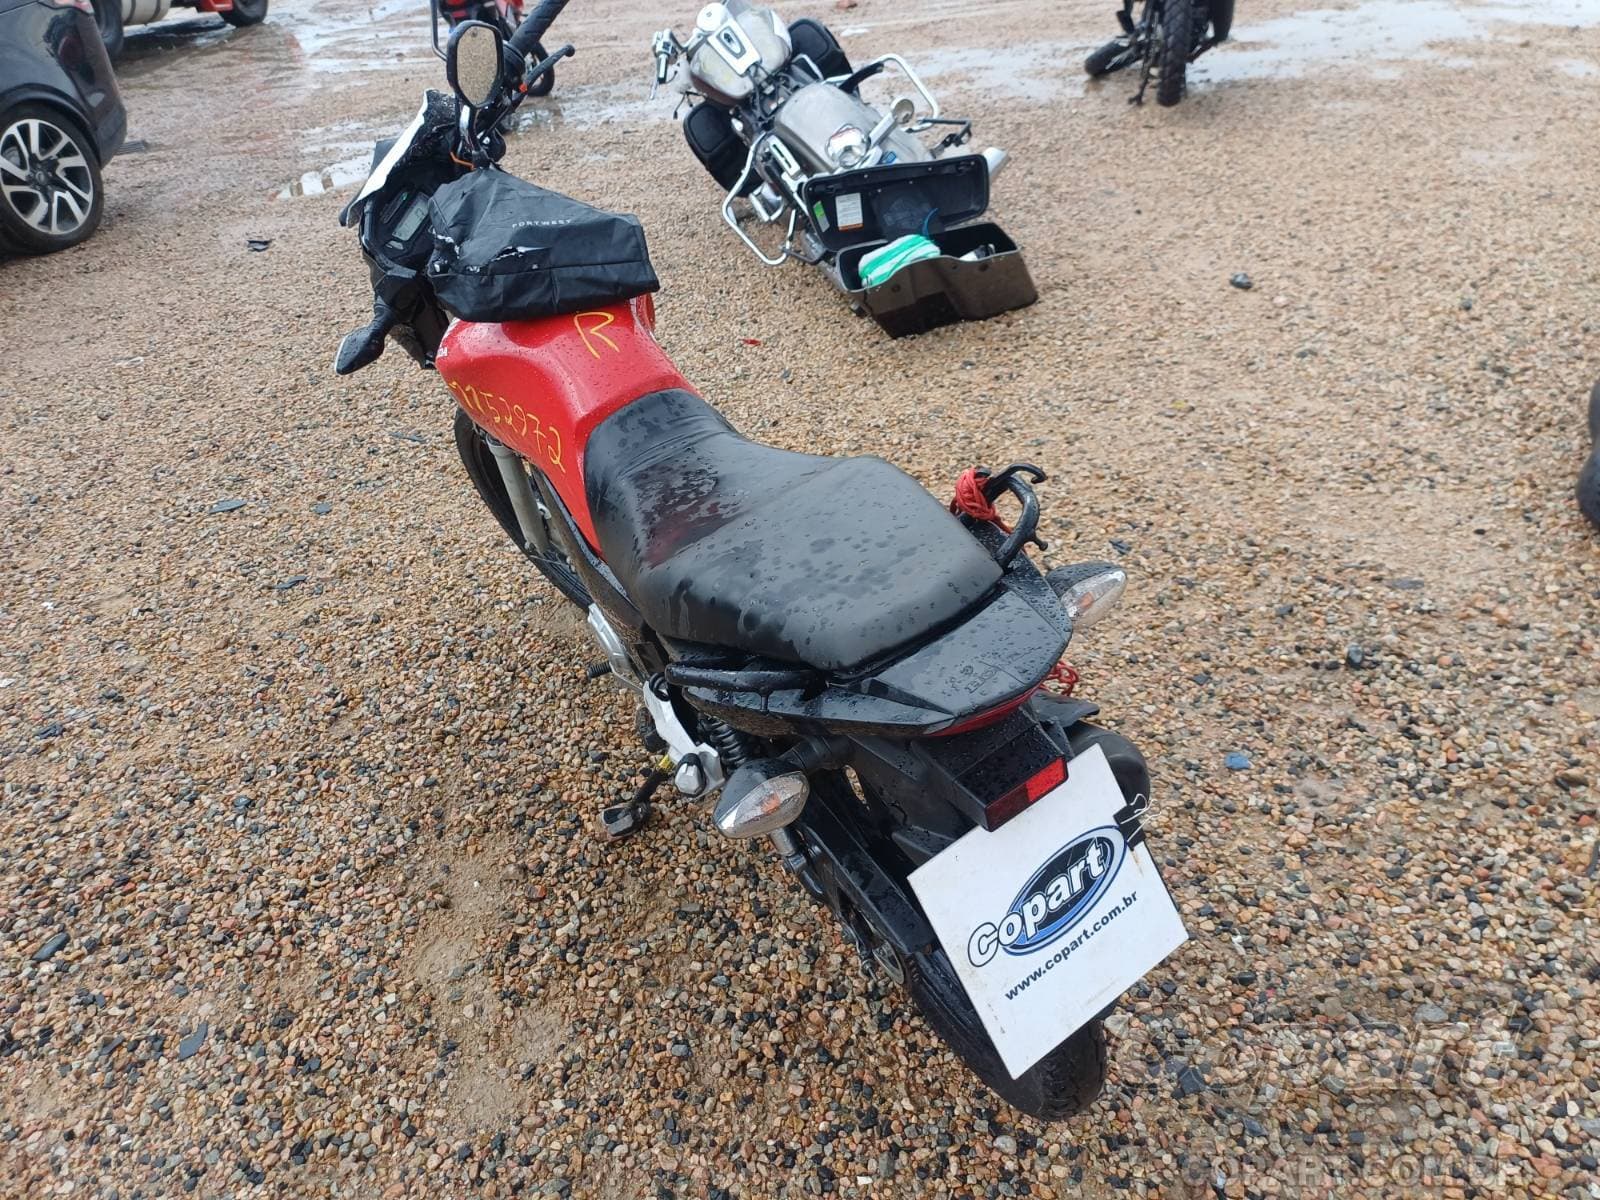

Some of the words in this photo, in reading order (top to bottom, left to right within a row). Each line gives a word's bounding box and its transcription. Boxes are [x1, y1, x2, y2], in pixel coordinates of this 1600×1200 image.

[573, 311, 620, 360] R
[967, 836, 1107, 968] Copart
[1005, 891, 1138, 1000] www.copart.com.br
